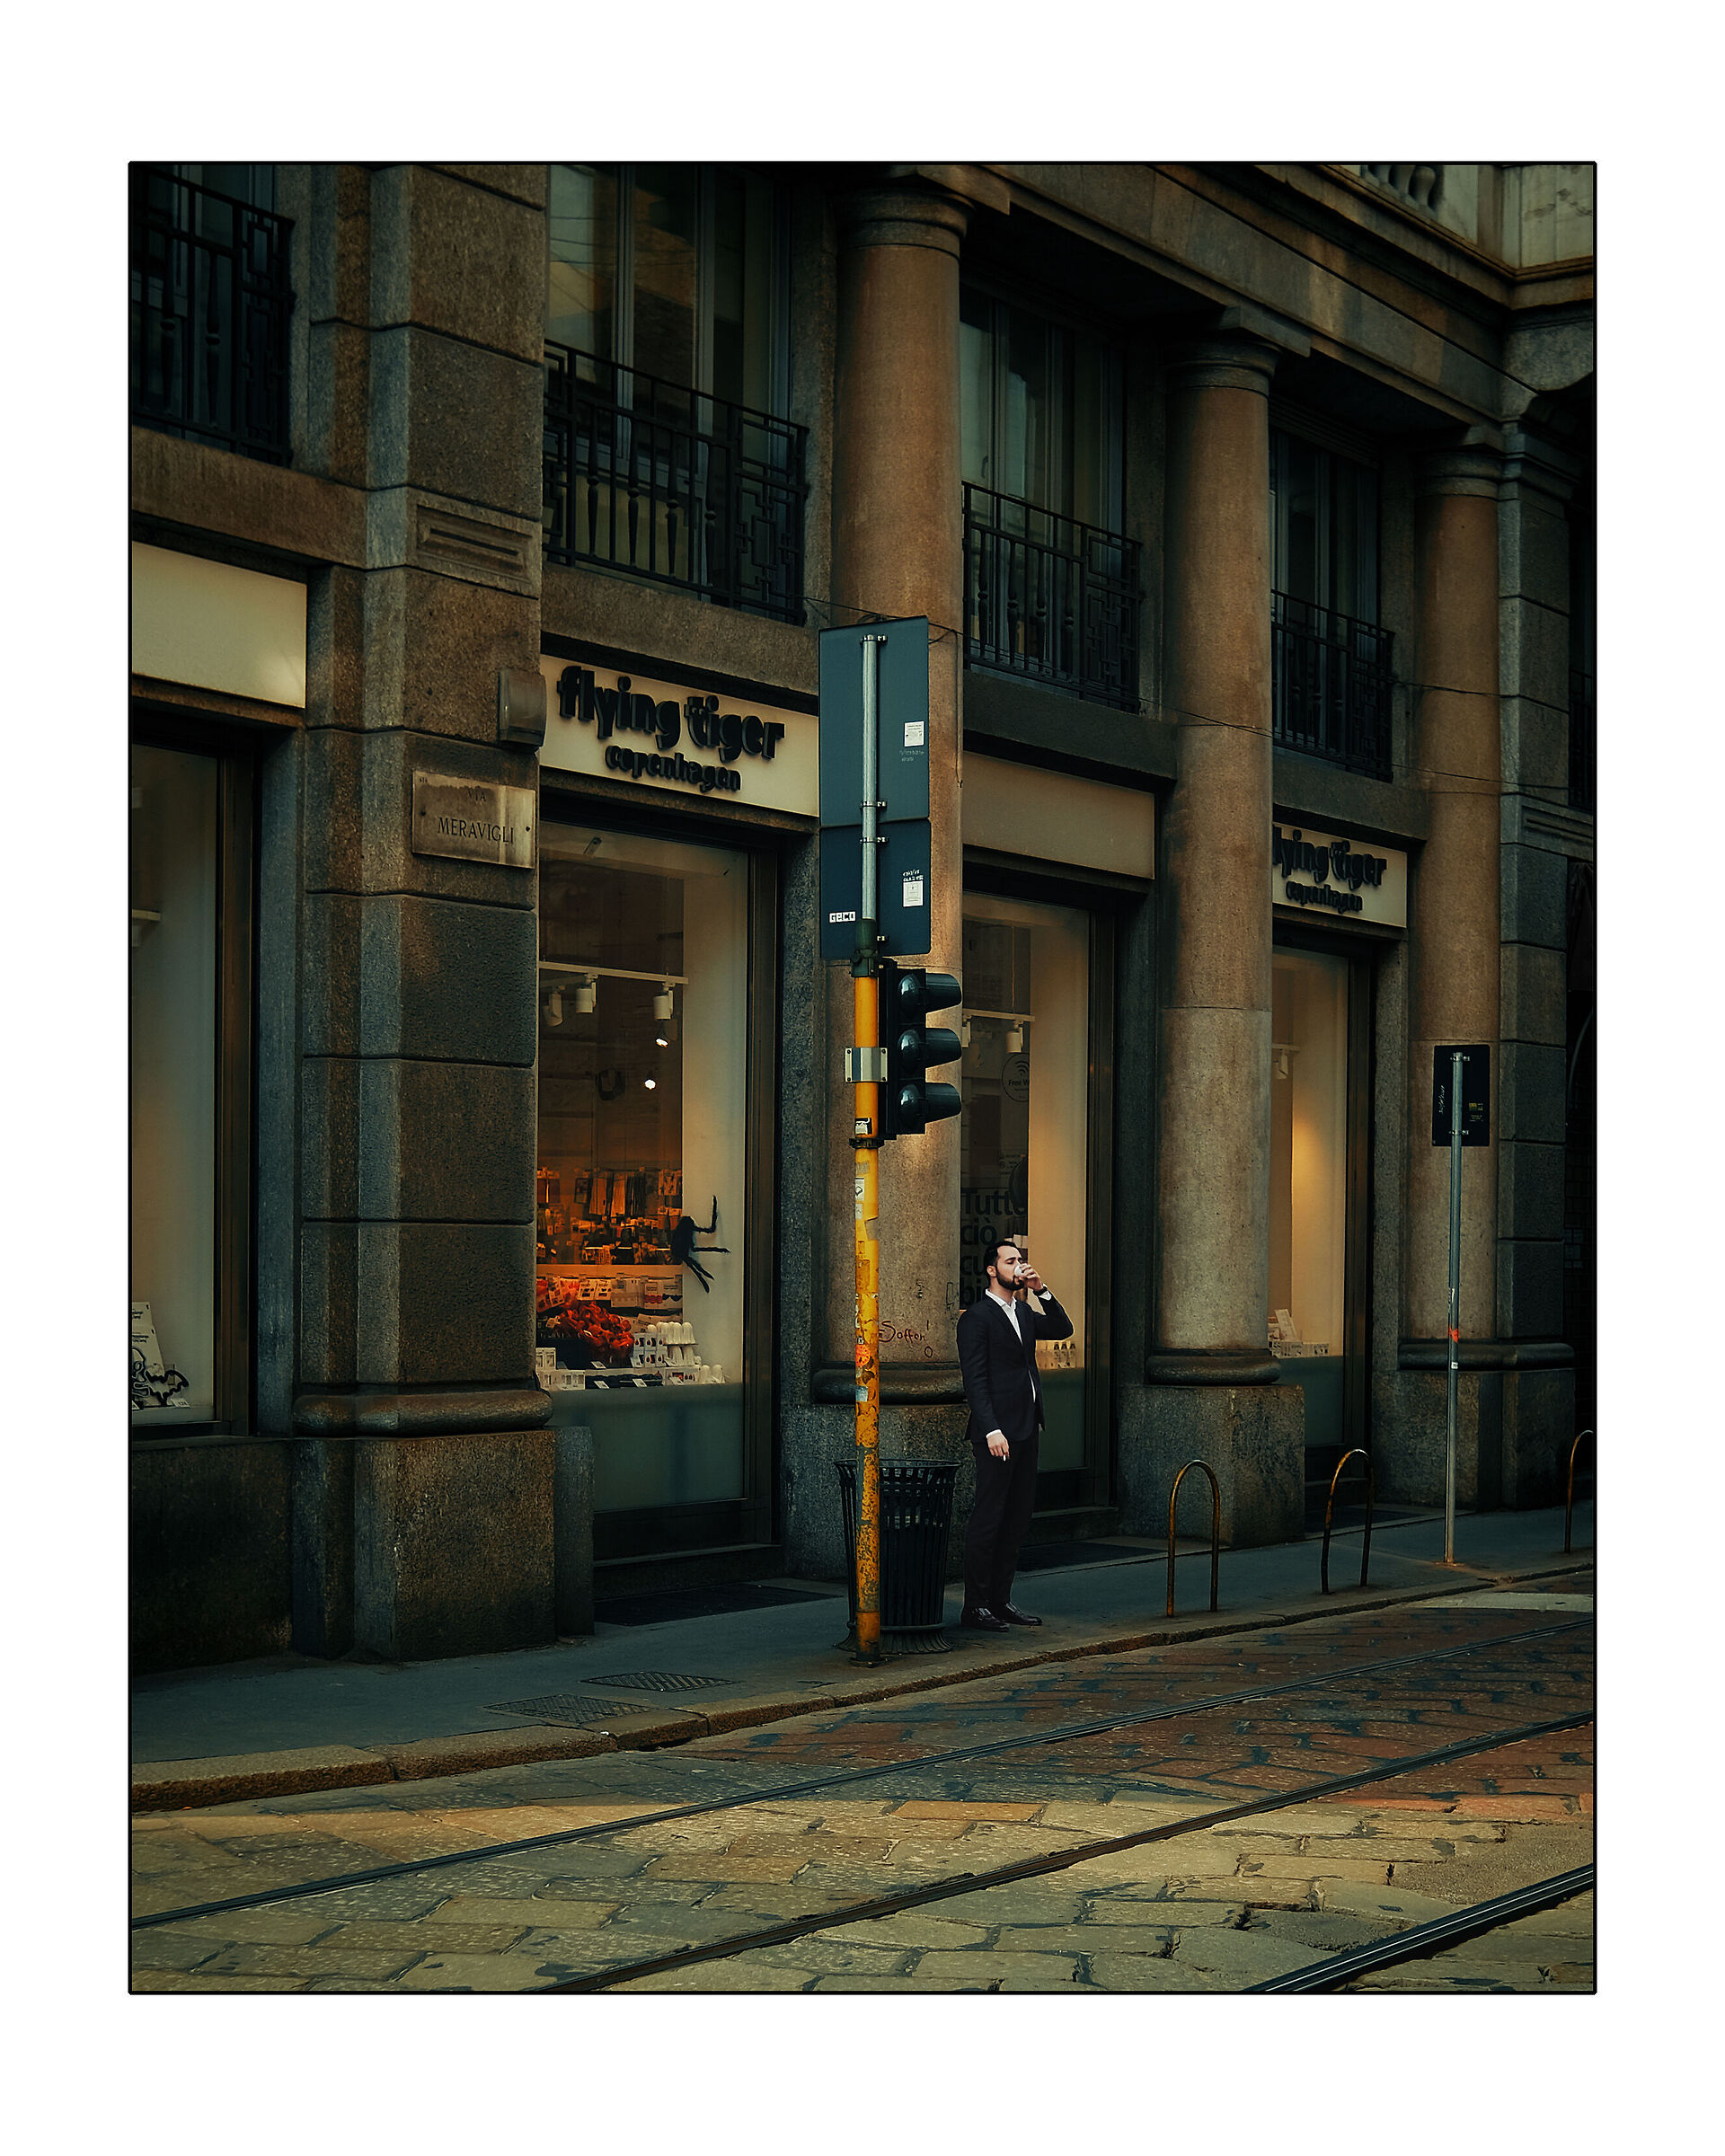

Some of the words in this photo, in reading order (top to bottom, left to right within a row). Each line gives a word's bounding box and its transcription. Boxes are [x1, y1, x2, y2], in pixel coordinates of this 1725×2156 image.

[556, 666, 680, 749] flying
[685, 695, 784, 762] tiger
[605, 745, 741, 792] copenhagen
[467, 788, 487, 802] VIA
[438, 817, 514, 844] MERAVIGLI
[1272, 826, 1329, 883] lying
[1331, 840, 1387, 890] tiger
[1286, 880, 1363, 915] copenhagen
[961, 1216, 997, 1245] ciò
